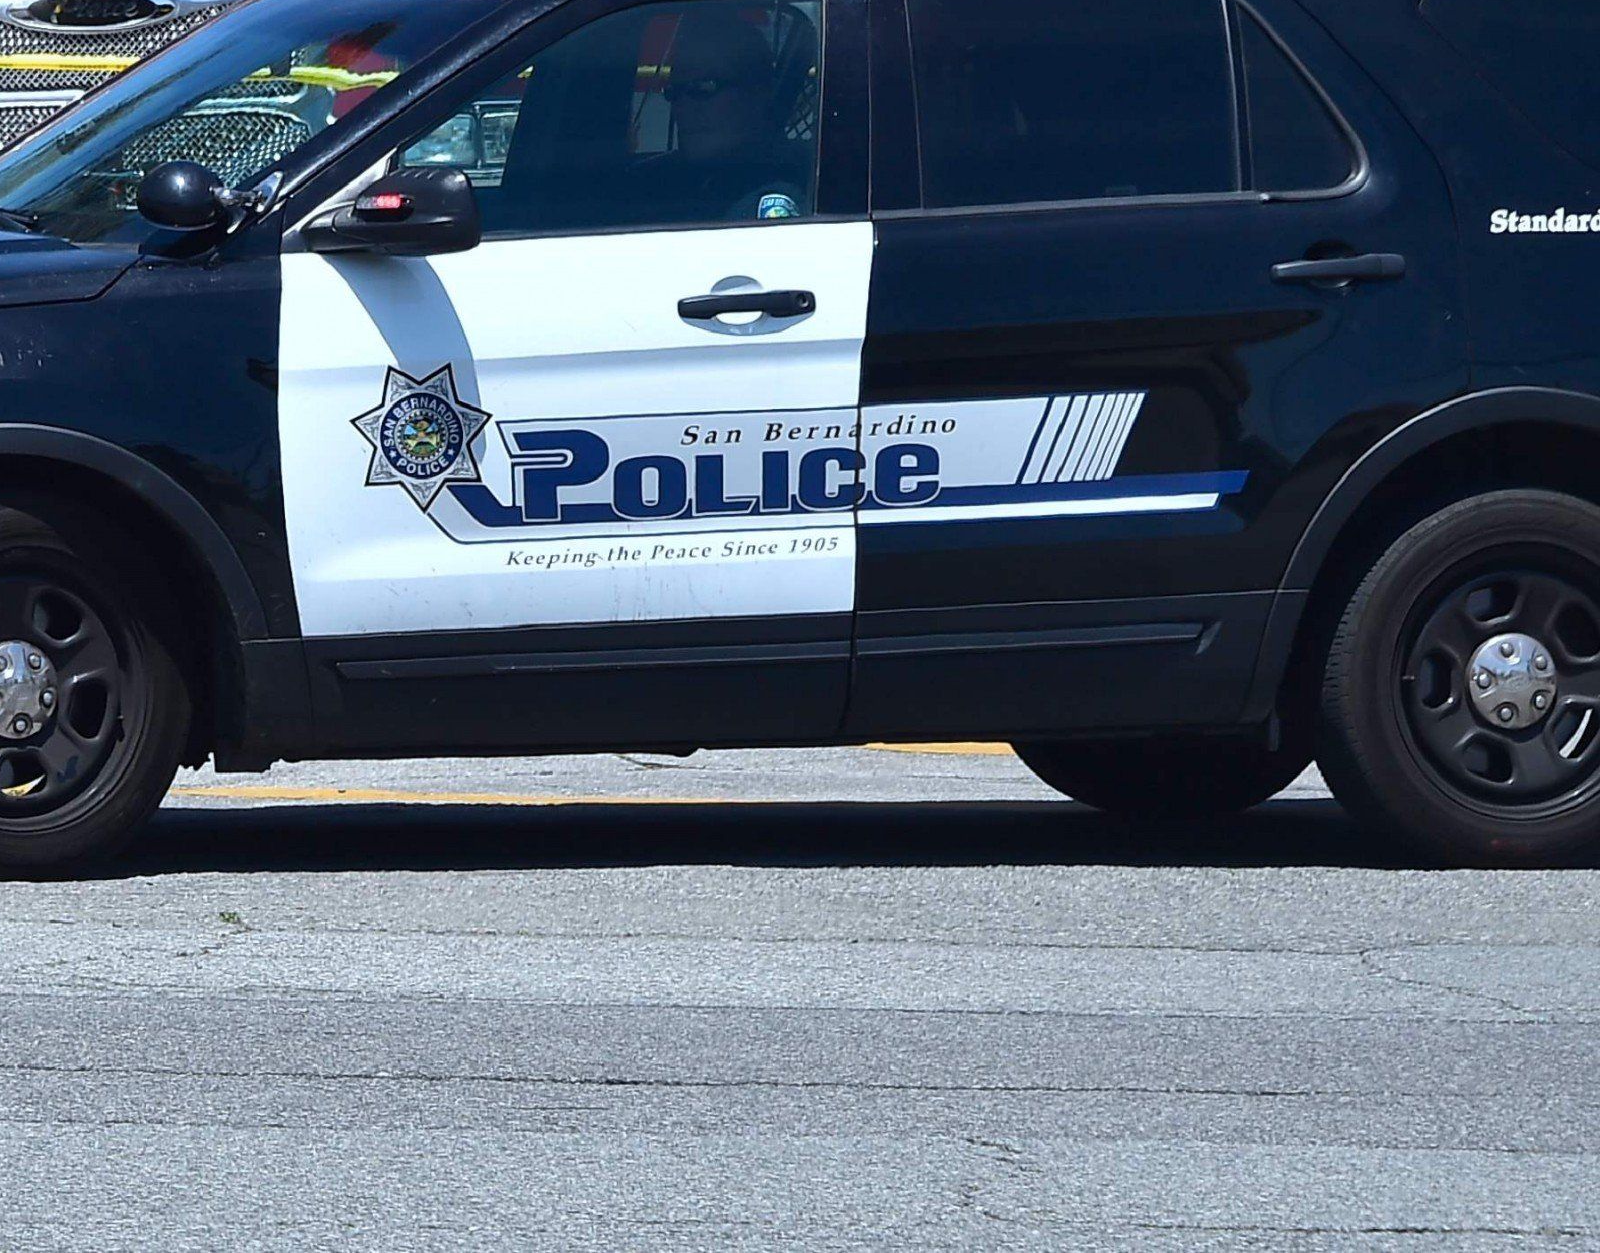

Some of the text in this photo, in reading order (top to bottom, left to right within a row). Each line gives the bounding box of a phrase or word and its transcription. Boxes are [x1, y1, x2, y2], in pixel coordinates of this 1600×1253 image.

[384, 396, 460, 447] SAN BERNARDINO
[680, 414, 958, 446] San Bernardino
[396, 455, 450, 476] POLICE
[506, 536, 840, 569] Keeping the Peace Since 1905
